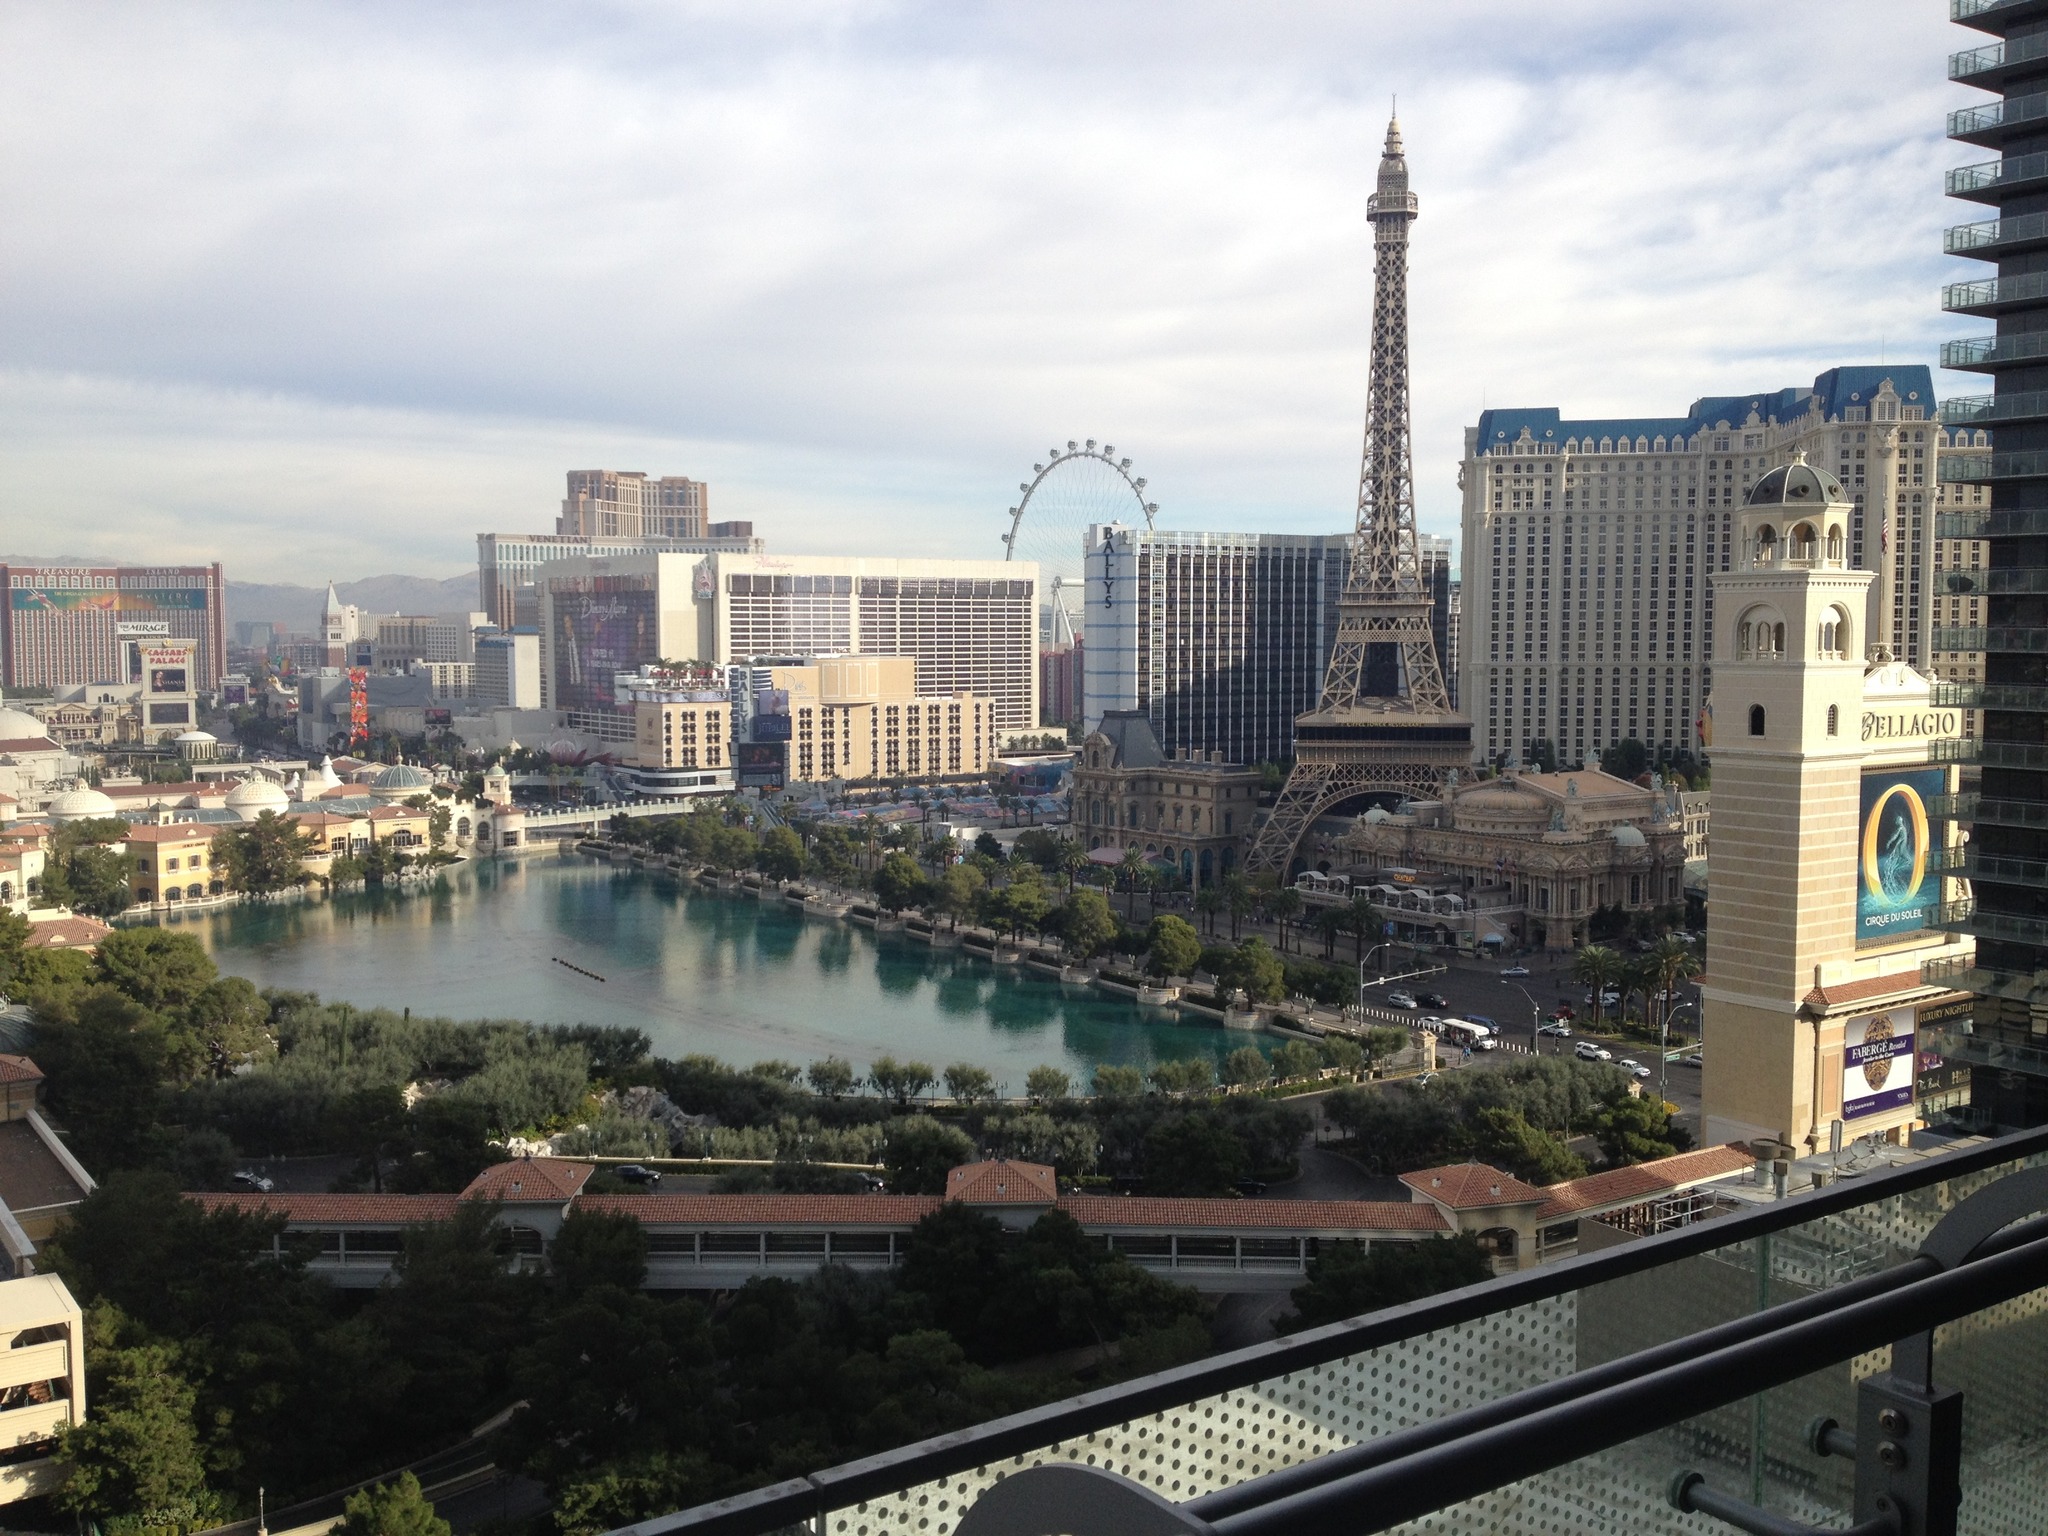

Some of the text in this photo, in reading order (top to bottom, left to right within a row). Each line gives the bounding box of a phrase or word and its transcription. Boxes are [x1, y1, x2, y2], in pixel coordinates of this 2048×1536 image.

[528, 534, 588, 544] VENETIAN
[35, 568, 91, 576] TREASURE
[123, 624, 167, 632] MIRAGE
[1861, 711, 1955, 741] BELLAGIO
[1865, 908, 1923, 927] CIRQUE DU SOLEIL
[1920, 1009, 1944, 1023] LUXURY
[1852, 1040, 1888, 1060] FABERGÉ
